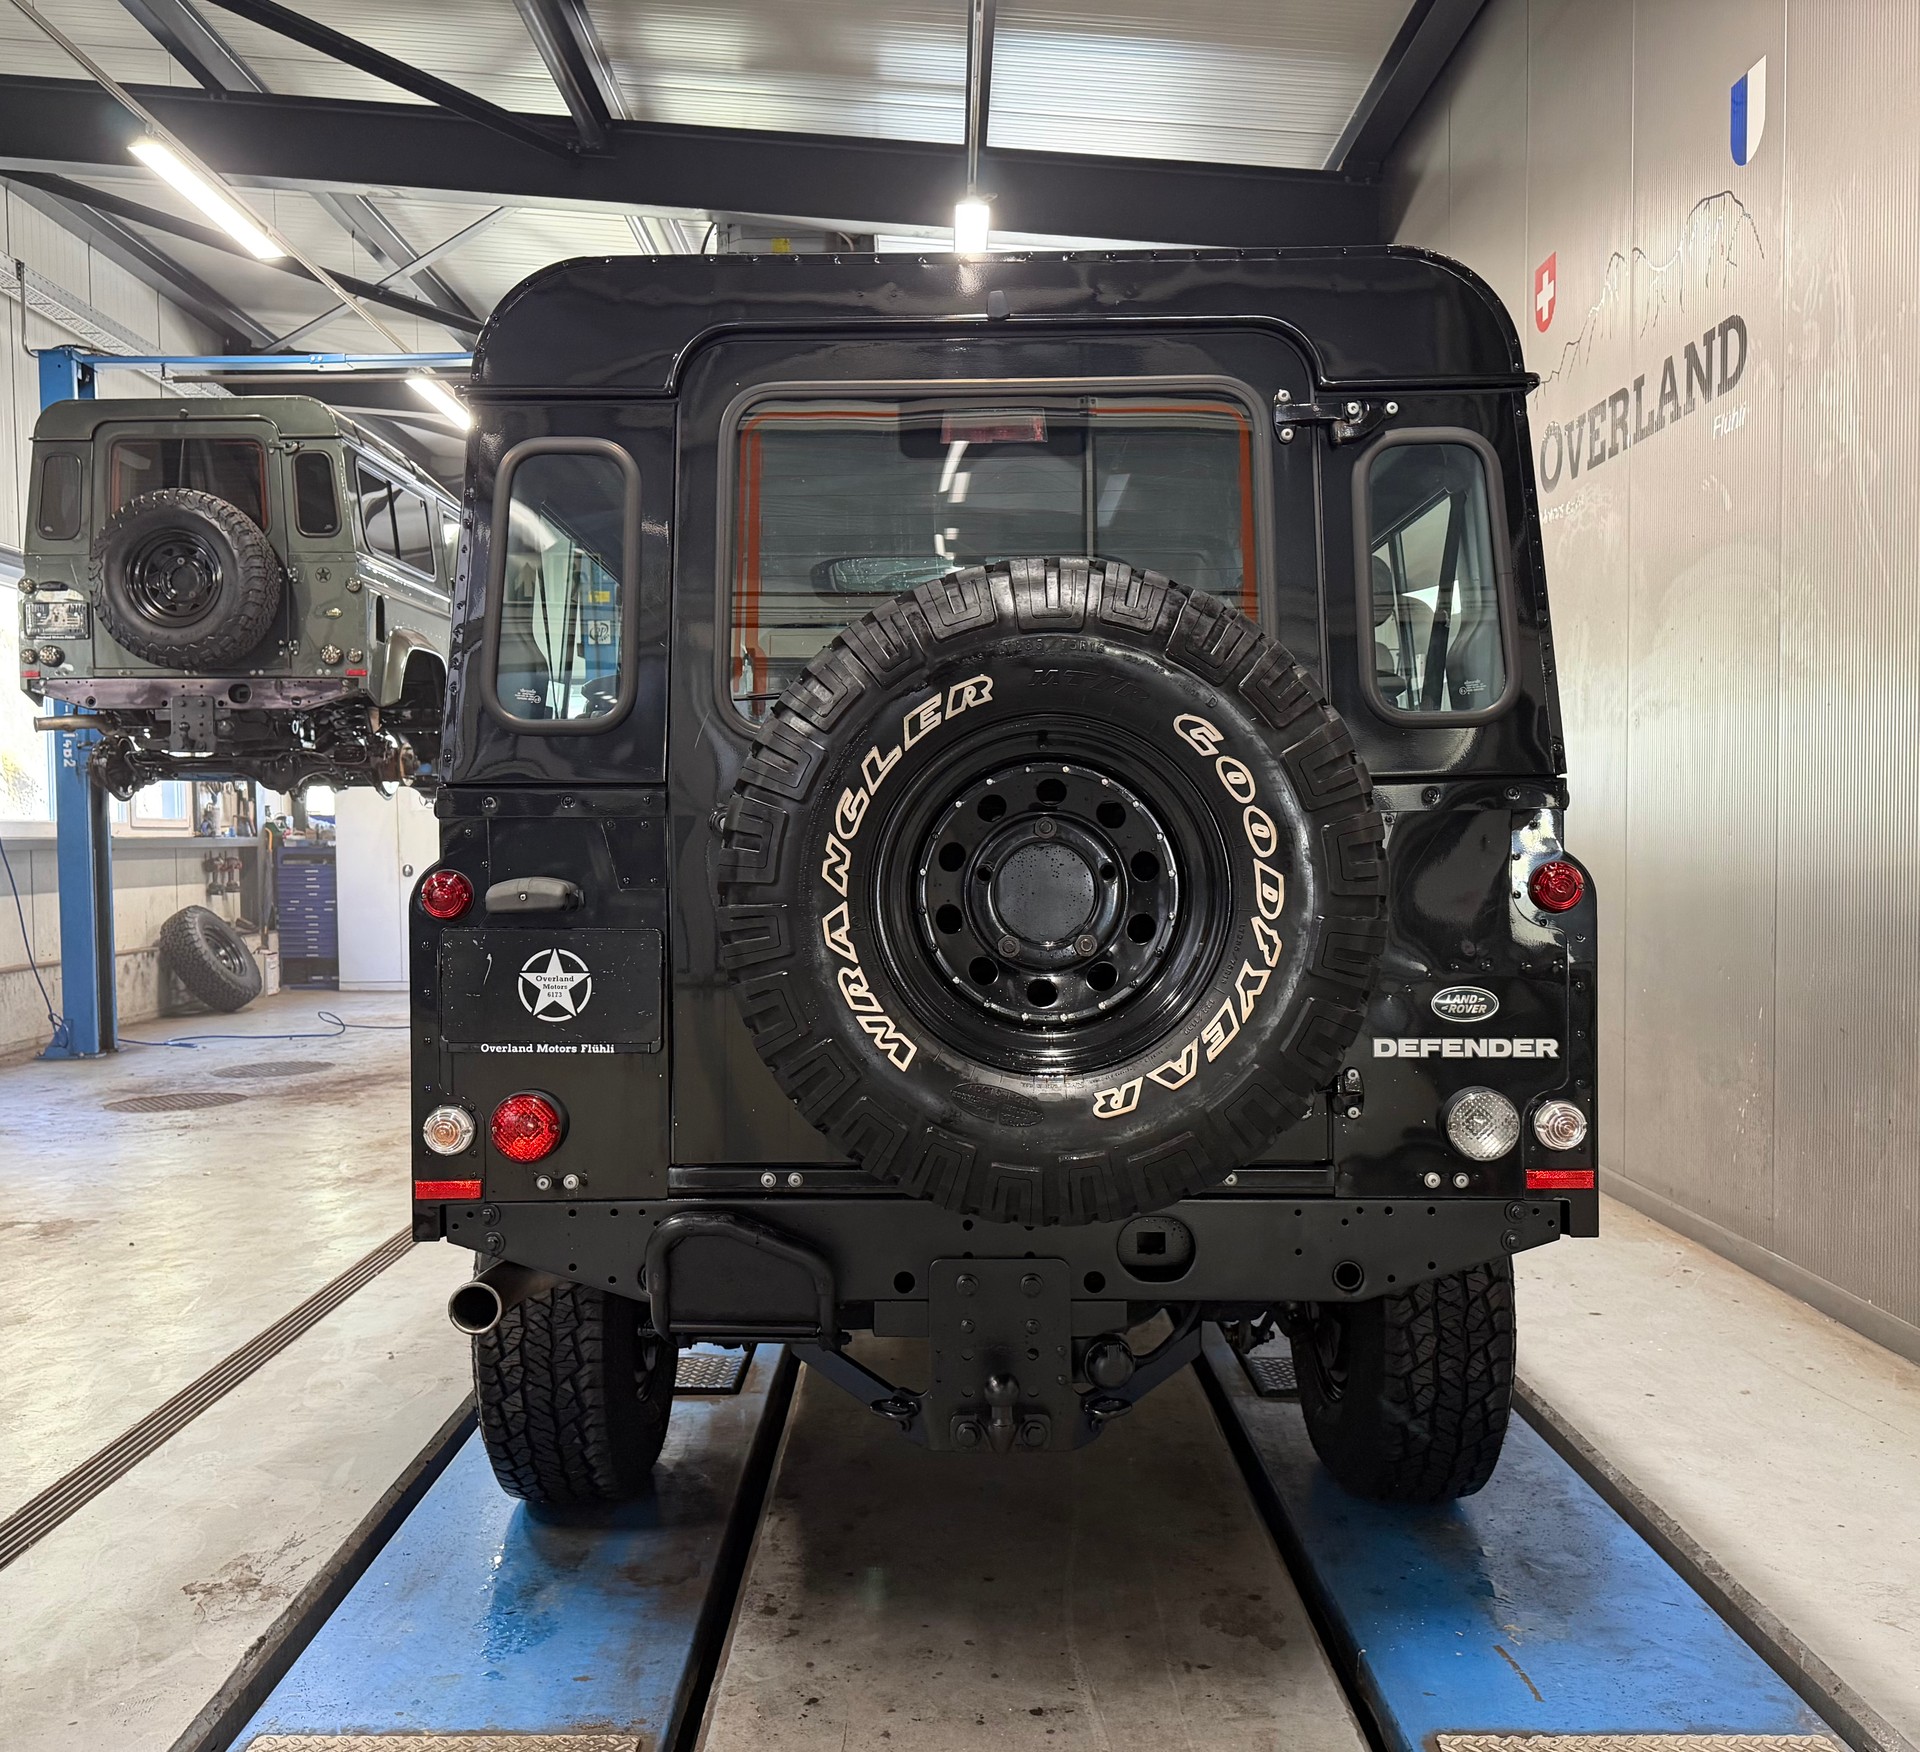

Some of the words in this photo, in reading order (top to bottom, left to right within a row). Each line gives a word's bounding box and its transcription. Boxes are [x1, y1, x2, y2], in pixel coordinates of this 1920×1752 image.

[1540, 314, 1748, 494] OVERLAND
[821, 673, 995, 1073] WRANGLER
[1092, 712, 1286, 1119] GOODYEAR
[535, 974, 575, 983] Overland
[1445, 994, 1478, 1004] LAND
[1448, 1004, 1488, 1014] ROVER
[480, 1043, 534, 1054] Overland
[536, 1043, 578, 1054] Motors
[580, 1042, 615, 1054] Flühli
[1372, 1037, 1561, 1059] DEFENDER
